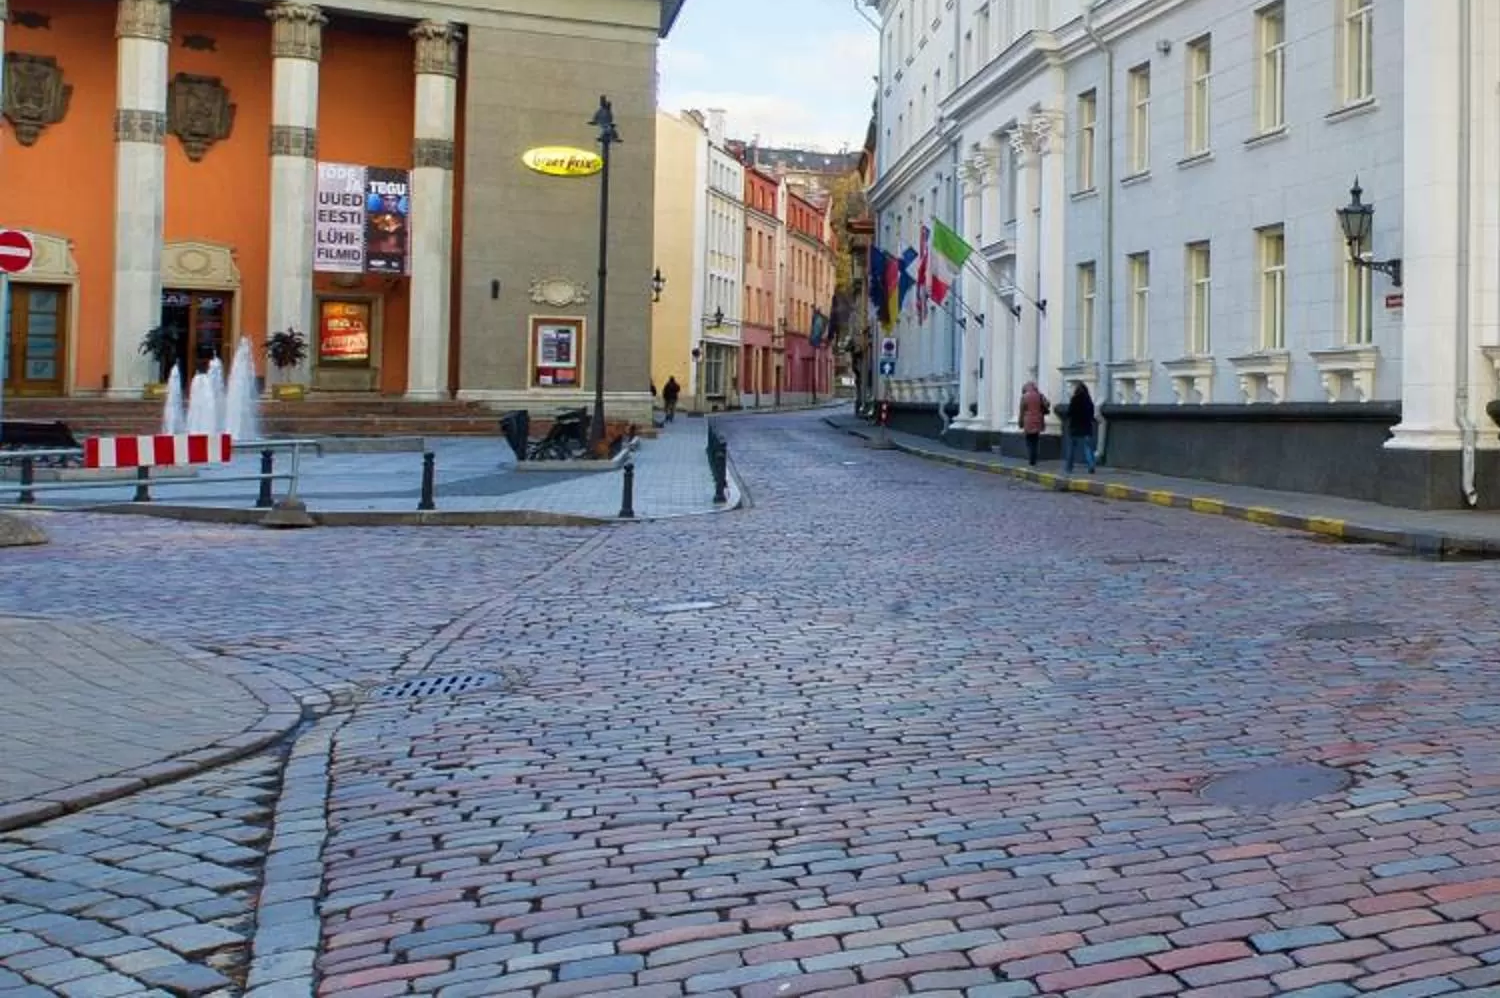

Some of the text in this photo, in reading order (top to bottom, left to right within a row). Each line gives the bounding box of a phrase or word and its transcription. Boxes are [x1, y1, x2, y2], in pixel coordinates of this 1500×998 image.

[369, 181, 406, 196] TEGU
[319, 191, 363, 207] UUED
[318, 208, 361, 225] EESTI
[317, 227, 361, 245] LÜHI-
[317, 247, 361, 261] FILMID
